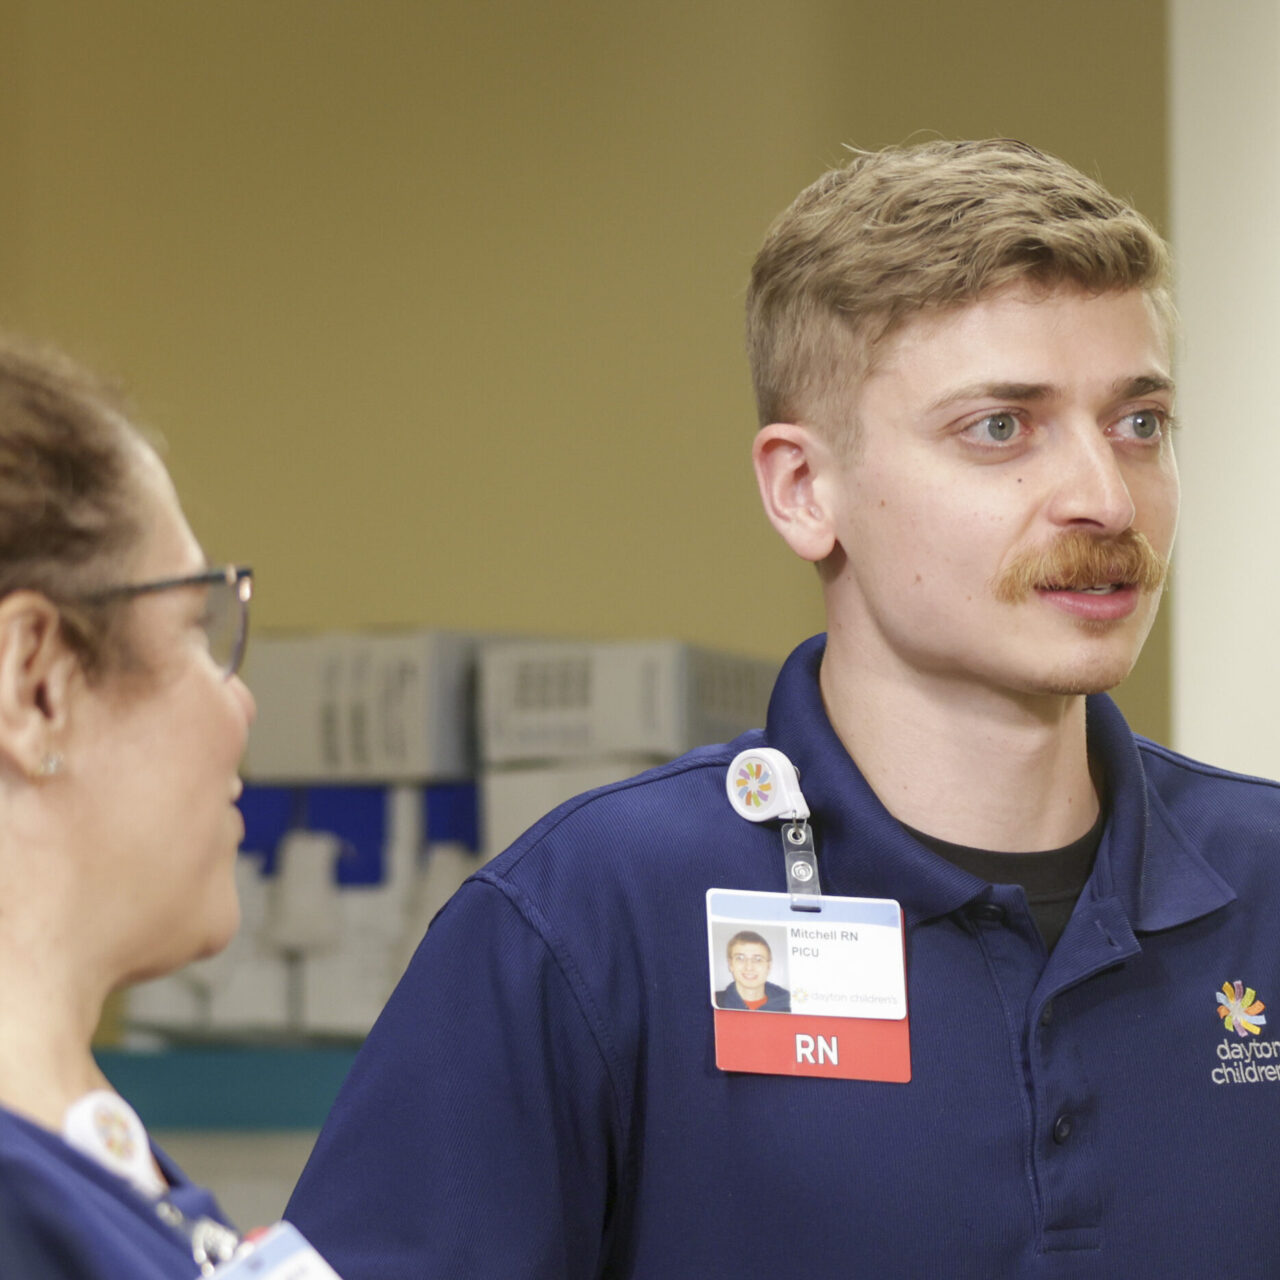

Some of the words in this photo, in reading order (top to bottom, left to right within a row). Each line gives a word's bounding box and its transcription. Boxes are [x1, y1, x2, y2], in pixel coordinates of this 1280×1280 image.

[790, 928, 837, 941] Mitchell
[840, 930, 859, 942] RN
[792, 946, 820, 958] PICU
[795, 1033, 839, 1066] RN
